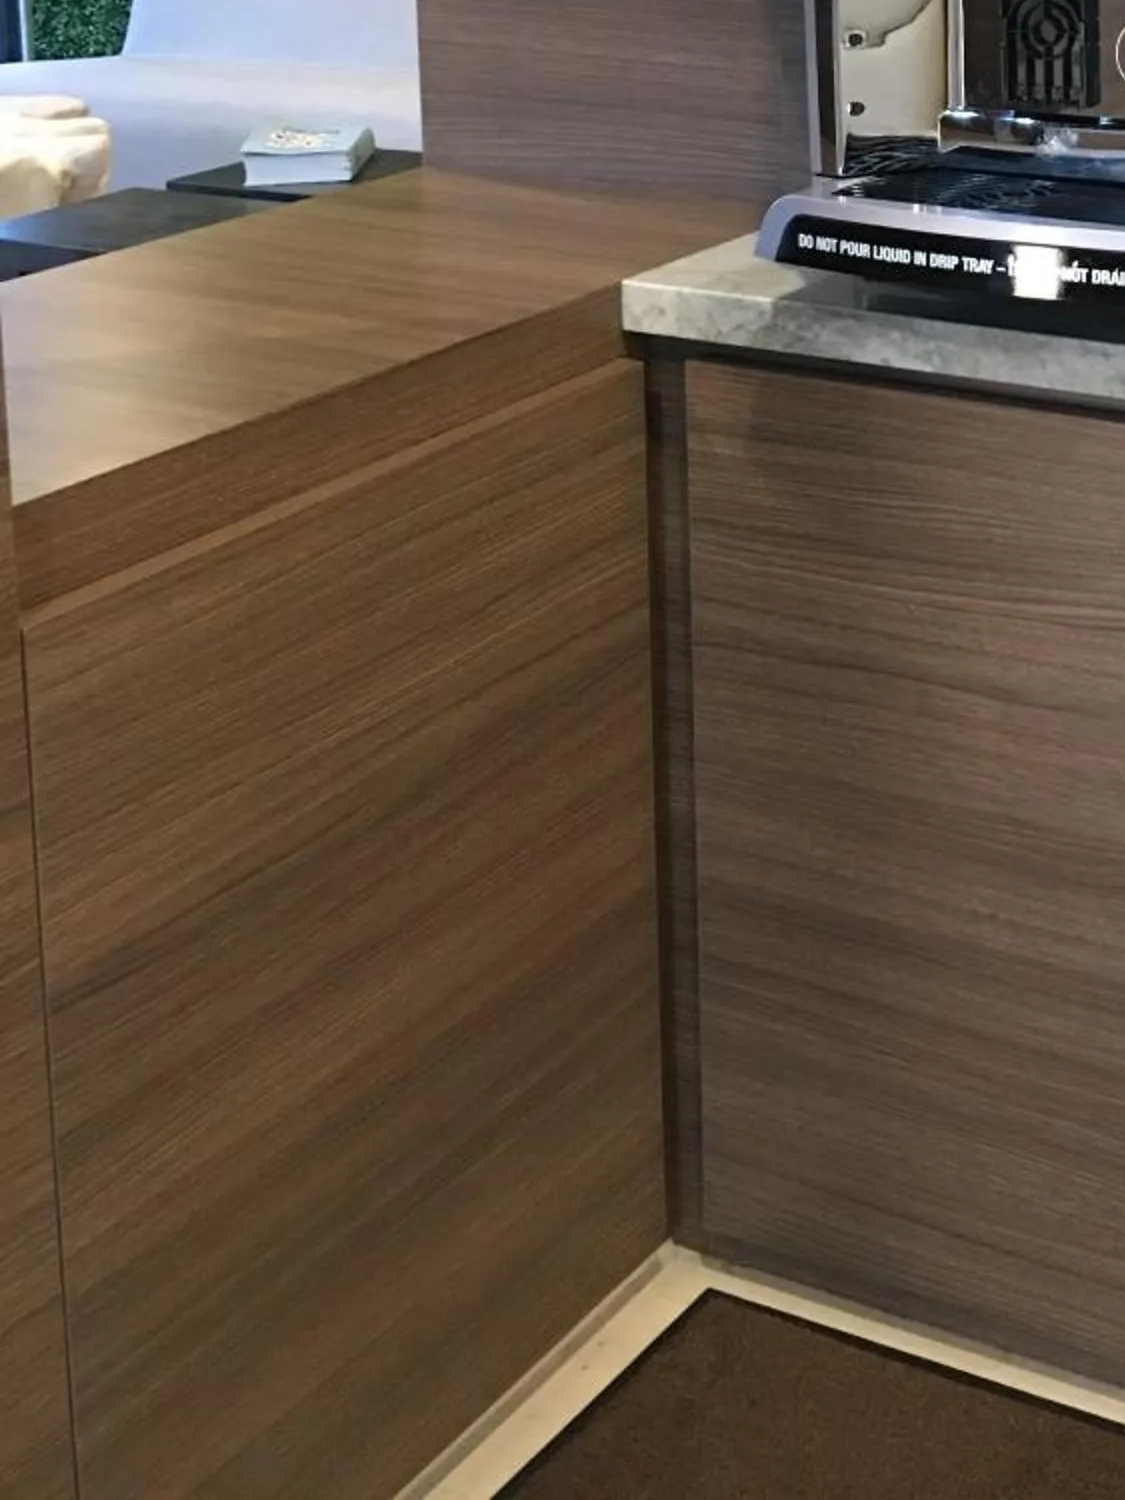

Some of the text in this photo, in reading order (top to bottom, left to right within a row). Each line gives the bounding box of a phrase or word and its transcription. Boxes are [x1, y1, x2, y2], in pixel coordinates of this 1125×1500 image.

[798, 232, 815, 249] DO
[816, 235, 838, 252] NOT
[839, 239, 871, 259] POUR
[873, 245, 912, 265] LIQUID
[914, 251, 927, 267] IN
[929, 253, 959, 271] DRIP
[962, 256, 995, 275] TRAY
